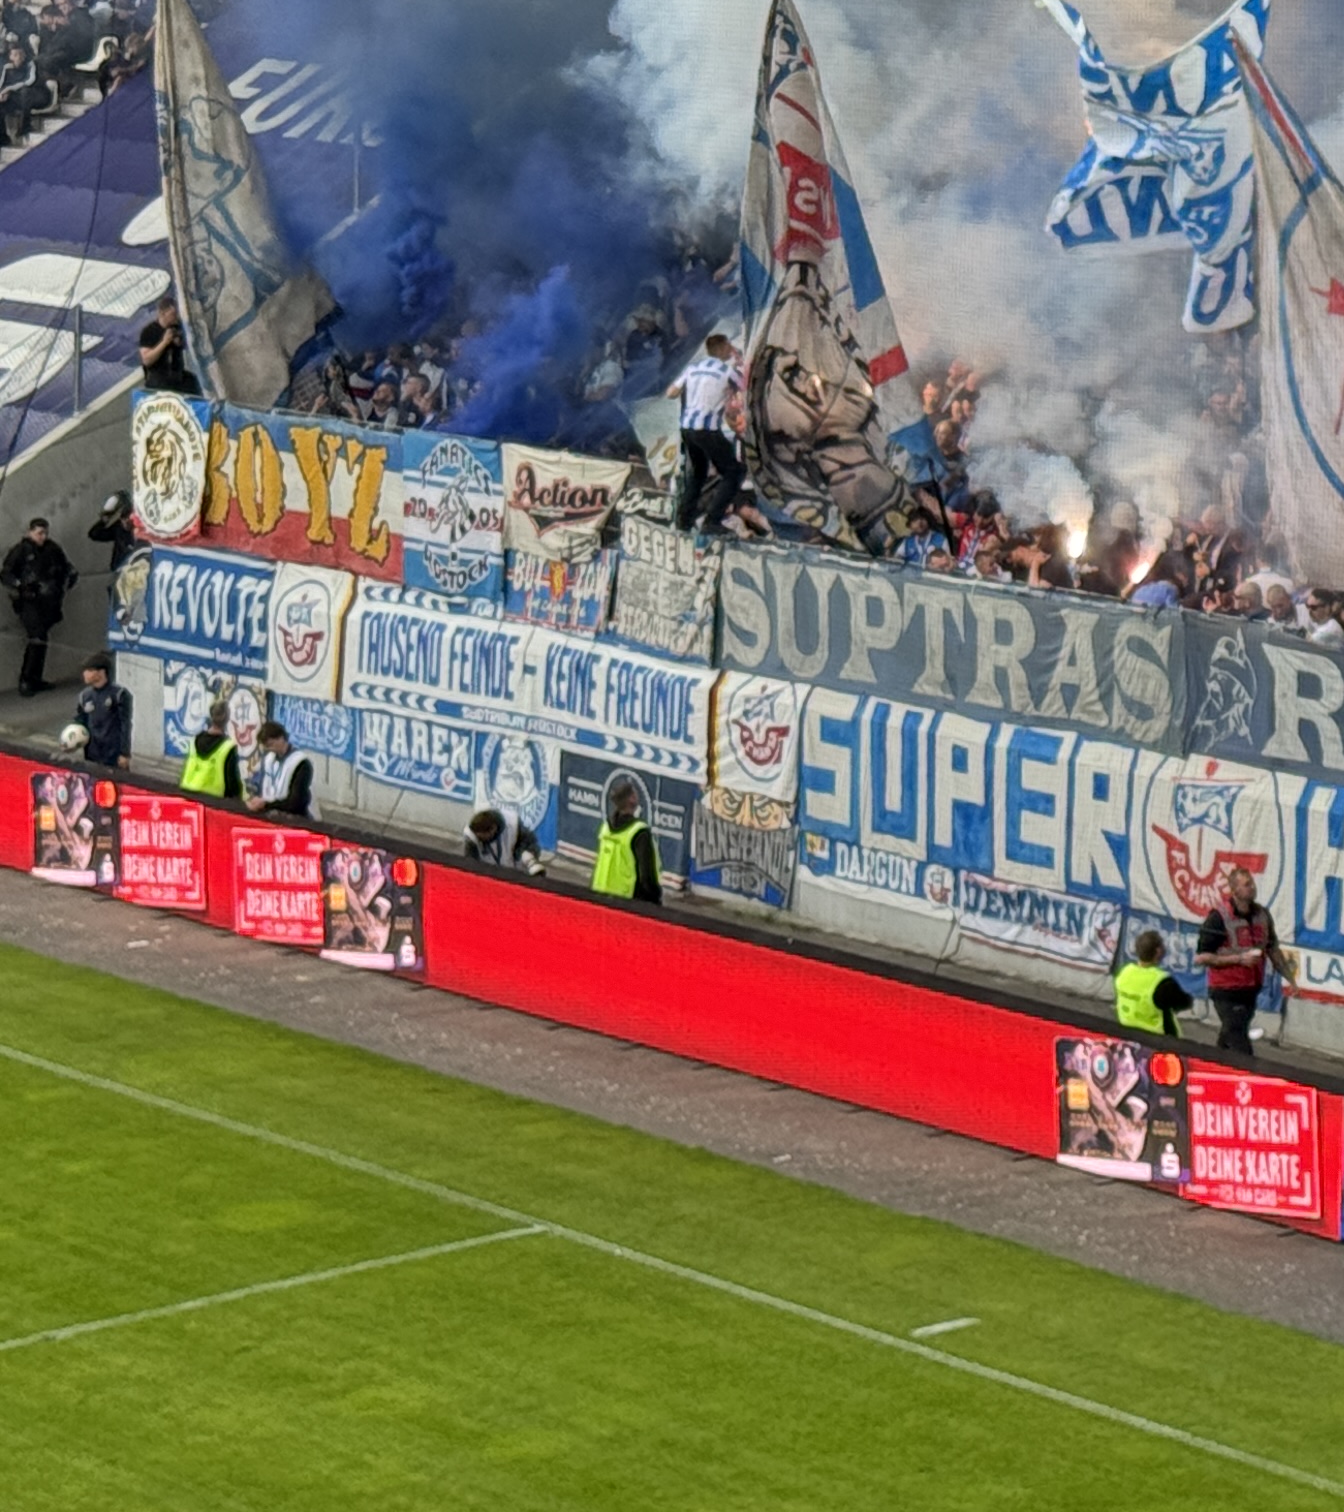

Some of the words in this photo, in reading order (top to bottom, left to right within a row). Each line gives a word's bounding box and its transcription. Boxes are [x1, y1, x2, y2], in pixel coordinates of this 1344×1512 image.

[511, 460, 617, 511] Action
[153, 560, 270, 647] REVOLTE
[720, 548, 1172, 745] SUPTRAS
[358, 610, 447, 688] TAUSEND
[451, 624, 524, 702] FEINDE
[543, 640, 602, 720] KEINE
[605, 655, 703, 745] FREUNDE
[361, 711, 470, 774] WAREN
[803, 686, 1135, 893] SUPER
[121, 819, 149, 848] DEIN
[150, 820, 193, 851] VEREIN
[123, 853, 156, 884] DEINE
[157, 855, 193, 886] KARTE
[245, 852, 275, 881] DEIN
[276, 853, 319, 885] VEREIN
[246, 888, 280, 919] DEINE
[281, 891, 320, 921] KARTE
[962, 875, 1087, 939] DEMMIN
[1192, 1101, 1234, 1138] DEIN
[1235, 1105, 1300, 1145] VEREIN
[1194, 1144, 1244, 1183] DEINE
[1245, 1150, 1301, 1190] KARTE
